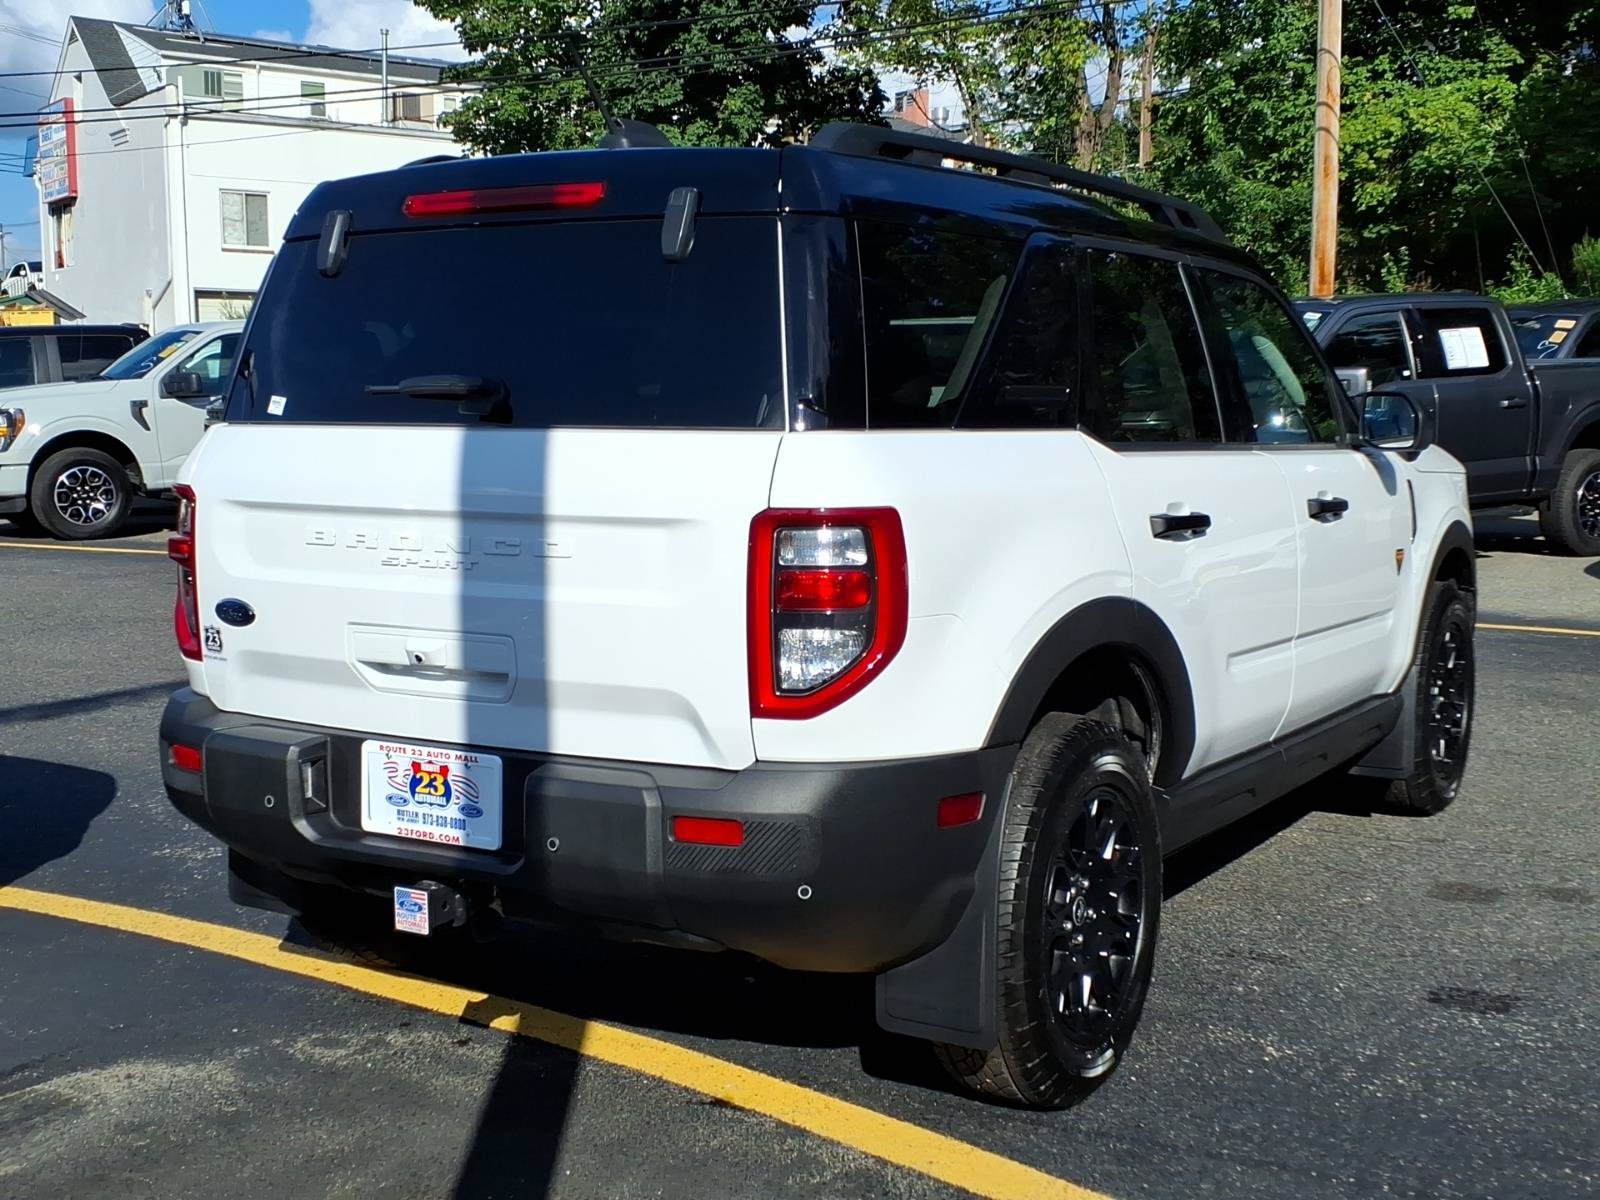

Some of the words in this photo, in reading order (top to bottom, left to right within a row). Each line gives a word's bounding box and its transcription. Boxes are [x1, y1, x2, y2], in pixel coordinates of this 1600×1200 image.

[305, 527, 573, 558] BRONCO
[381, 554, 480, 571] SPORT
[206, 632, 221, 648] 23
[379, 744, 407, 755] ROUTE
[410, 748, 423, 757] 23
[426, 751, 451, 760] AUTO
[454, 754, 480, 764] MALL
[415, 770, 446, 797] 23
[396, 808, 420, 819] BUTLER
[396, 826, 461, 845] 23FORD.COM
